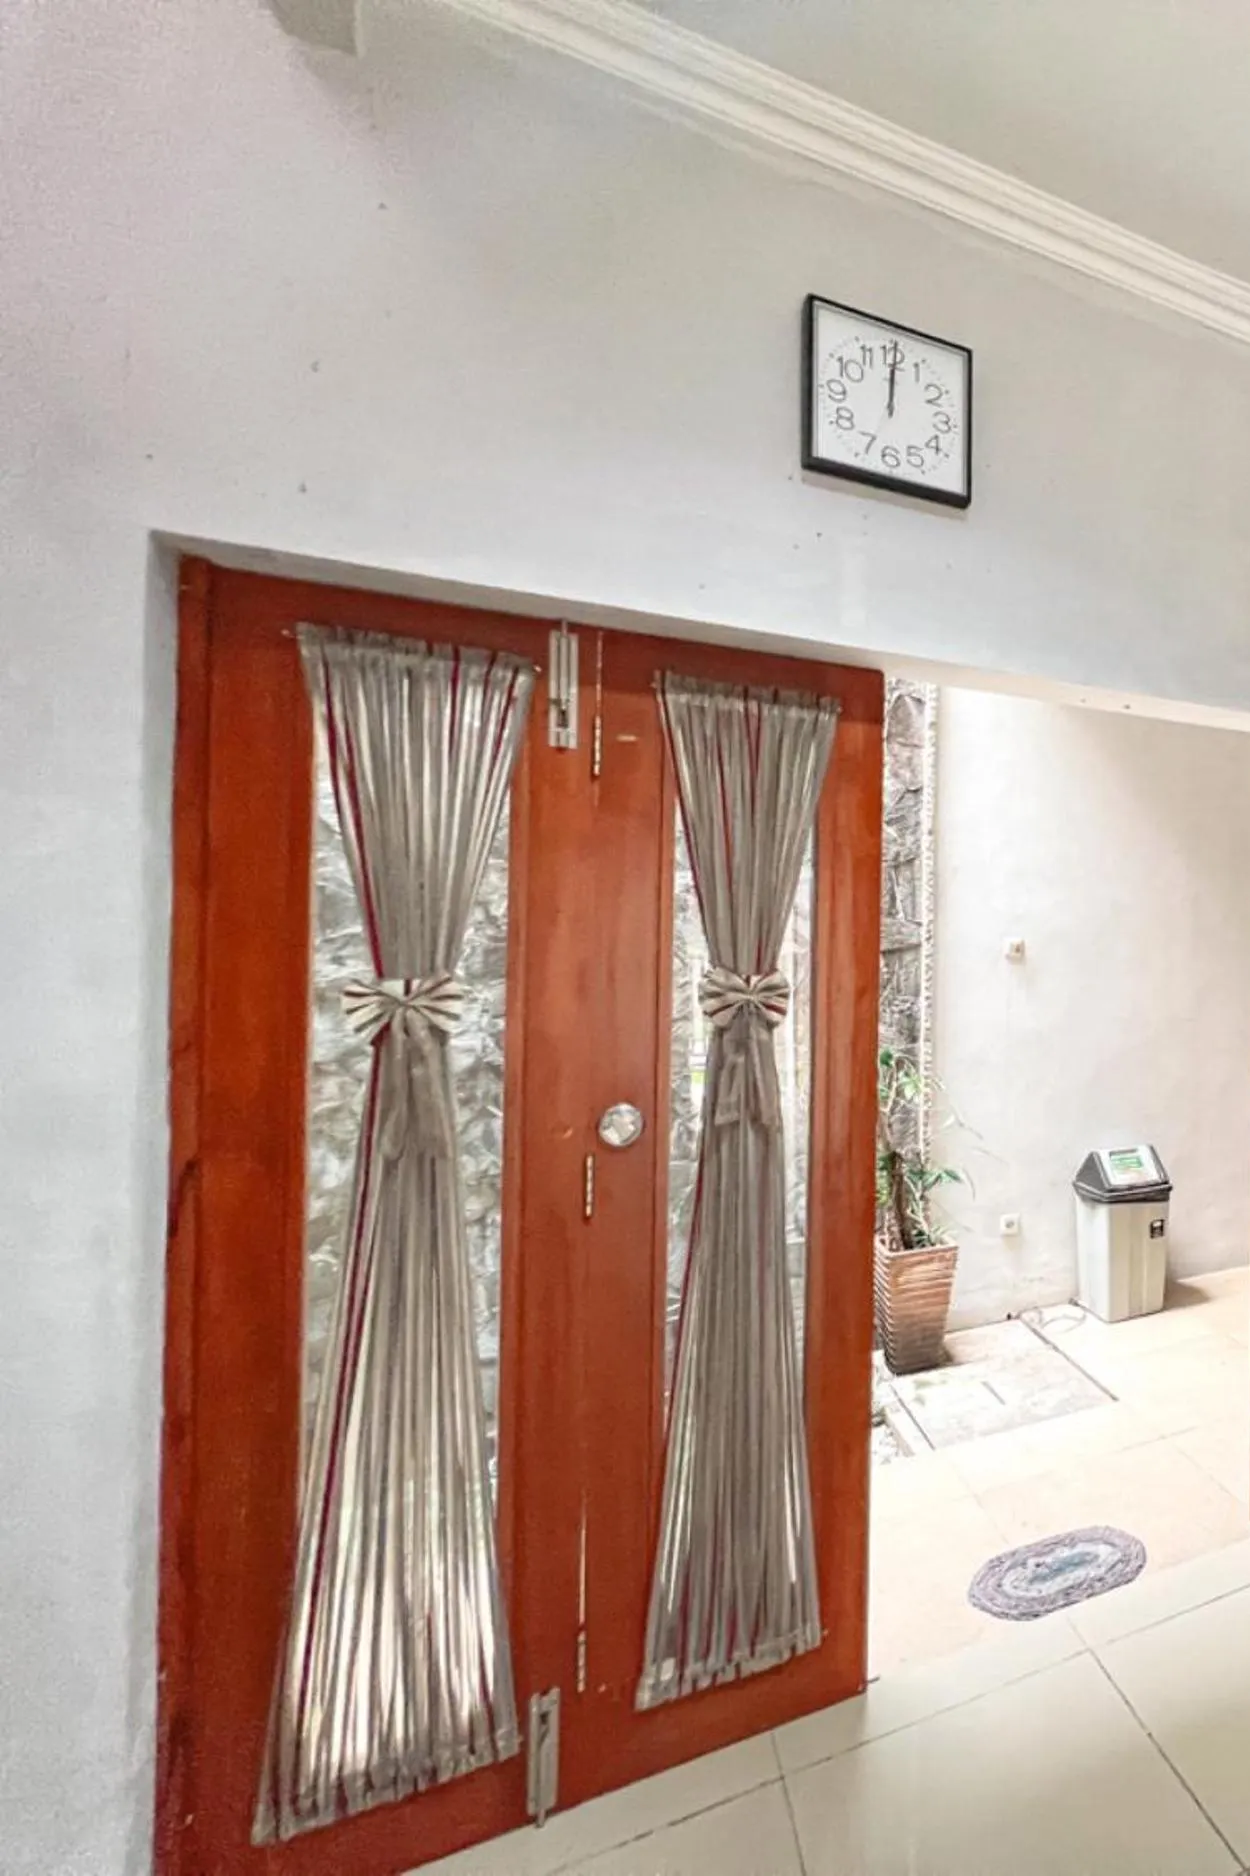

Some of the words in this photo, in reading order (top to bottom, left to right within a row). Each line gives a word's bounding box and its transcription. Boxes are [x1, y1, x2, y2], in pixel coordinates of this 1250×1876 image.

[860, 344, 873, 369] 11
[836, 356, 863, 382] 10
[913, 361, 920, 384] 1
[826, 378, 847, 403] 9
[924, 383, 943, 408] 2
[835, 406, 855, 431] 8
[932, 411, 951, 434] 3
[859, 430, 876, 454] 7
[924, 434, 942, 455] 4
[881, 445, 901, 468] 6
[906, 444, 925, 468] 5
